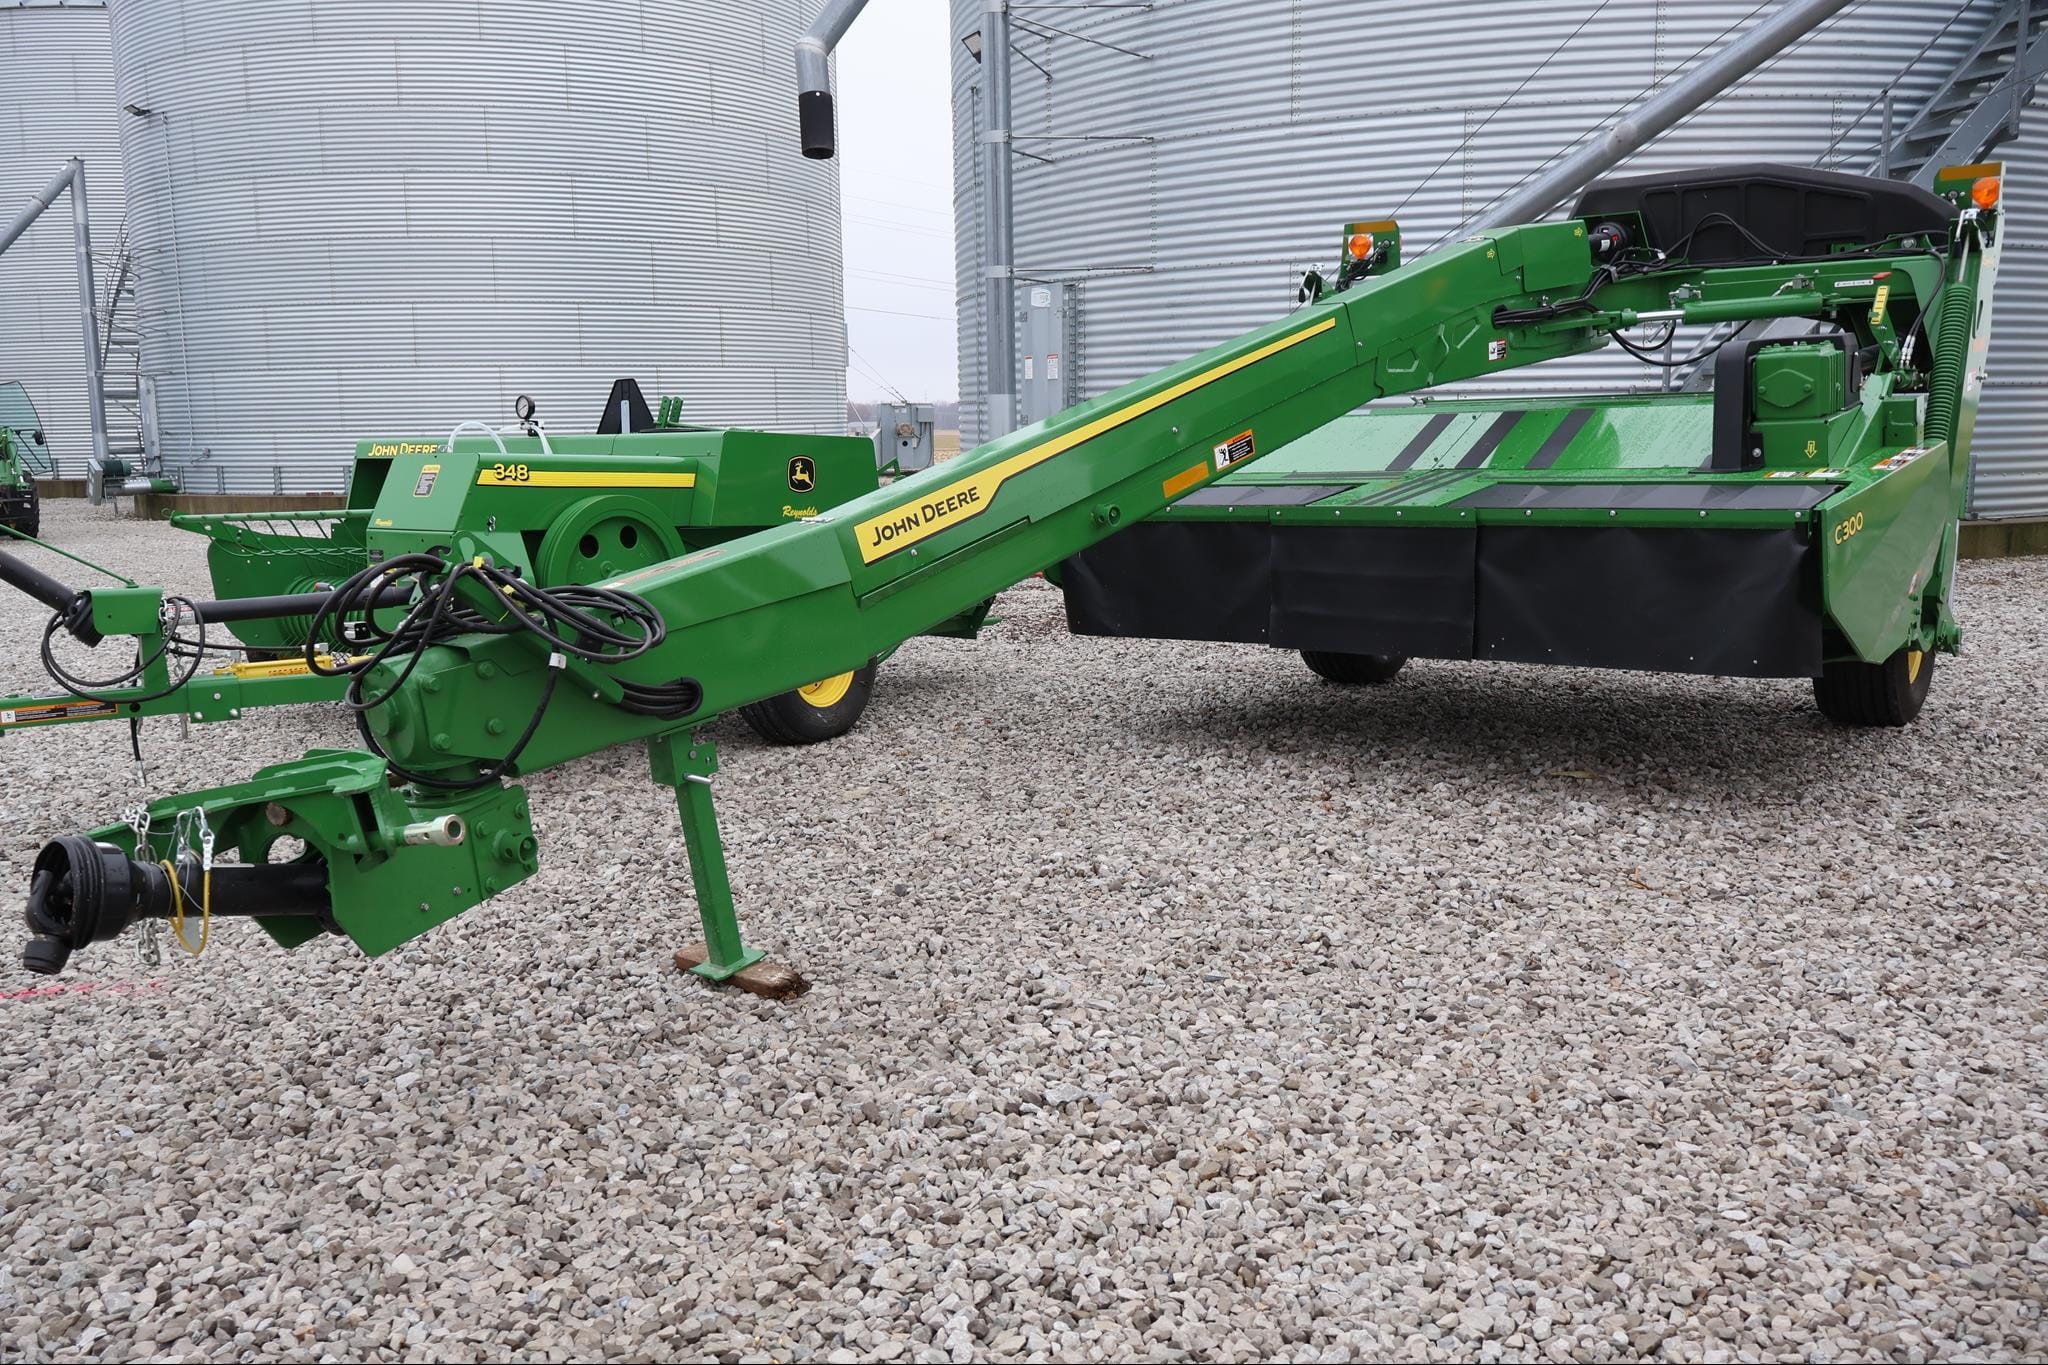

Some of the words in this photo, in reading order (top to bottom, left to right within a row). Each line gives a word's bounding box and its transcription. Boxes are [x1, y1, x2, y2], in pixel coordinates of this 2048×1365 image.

[368, 443, 398, 456] JOHN
[399, 442, 438, 454] DEERE
[494, 463, 528, 480] 348
[872, 513, 920, 547] JOHN
[921, 486, 980, 524] DEERE
[1834, 511, 1864, 545] C300
